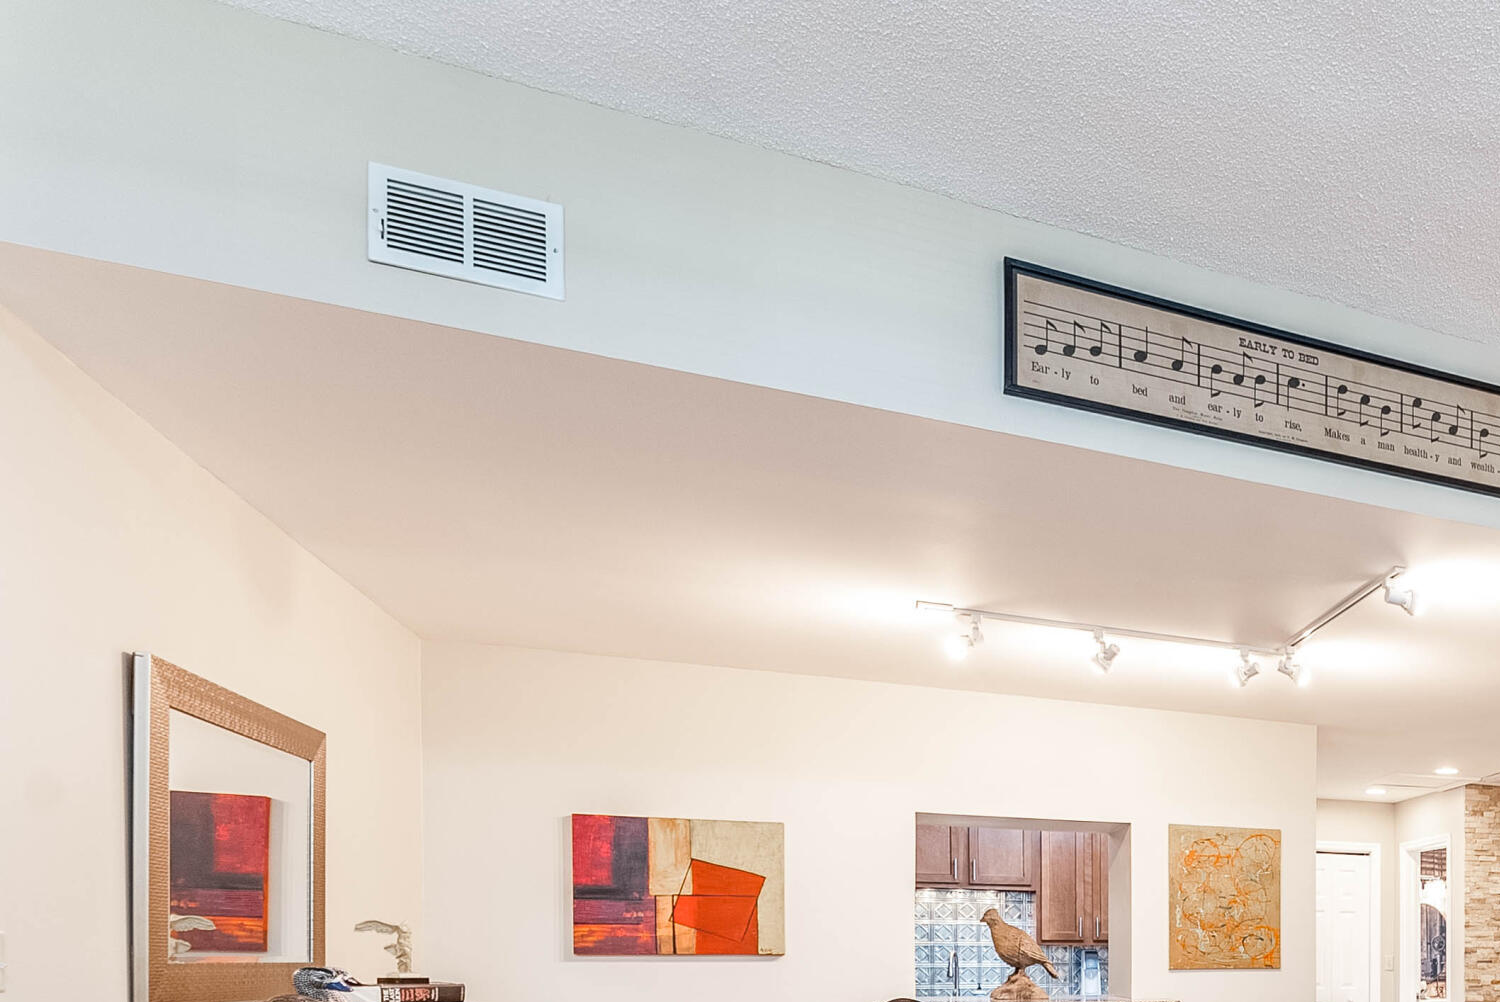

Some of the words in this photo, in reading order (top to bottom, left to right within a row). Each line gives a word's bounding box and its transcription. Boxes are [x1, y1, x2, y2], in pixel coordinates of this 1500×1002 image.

[1239, 337, 1278, 355] EARLY
[1282, 348, 1295, 359] TO
[1298, 352, 1319, 366] BED
[1031, 361, 1050, 374] Ear
[1061, 368, 1071, 380] ly
[1090, 375, 1100, 385] to
[1132, 384, 1148, 397] bed
[1168, 394, 1186, 405] and
[1207, 403, 1223, 413] ear
[1233, 407, 1242, 418] ly
[1255, 413, 1264, 422] to
[1324, 427, 1351, 441] Makes
[1360, 437, 1366, 445] a
[1377, 441, 1395, 452] man
[1404, 445, 1428, 459] health
[1447, 456, 1462, 466] and
[1470, 461, 1495, 473] wealth
